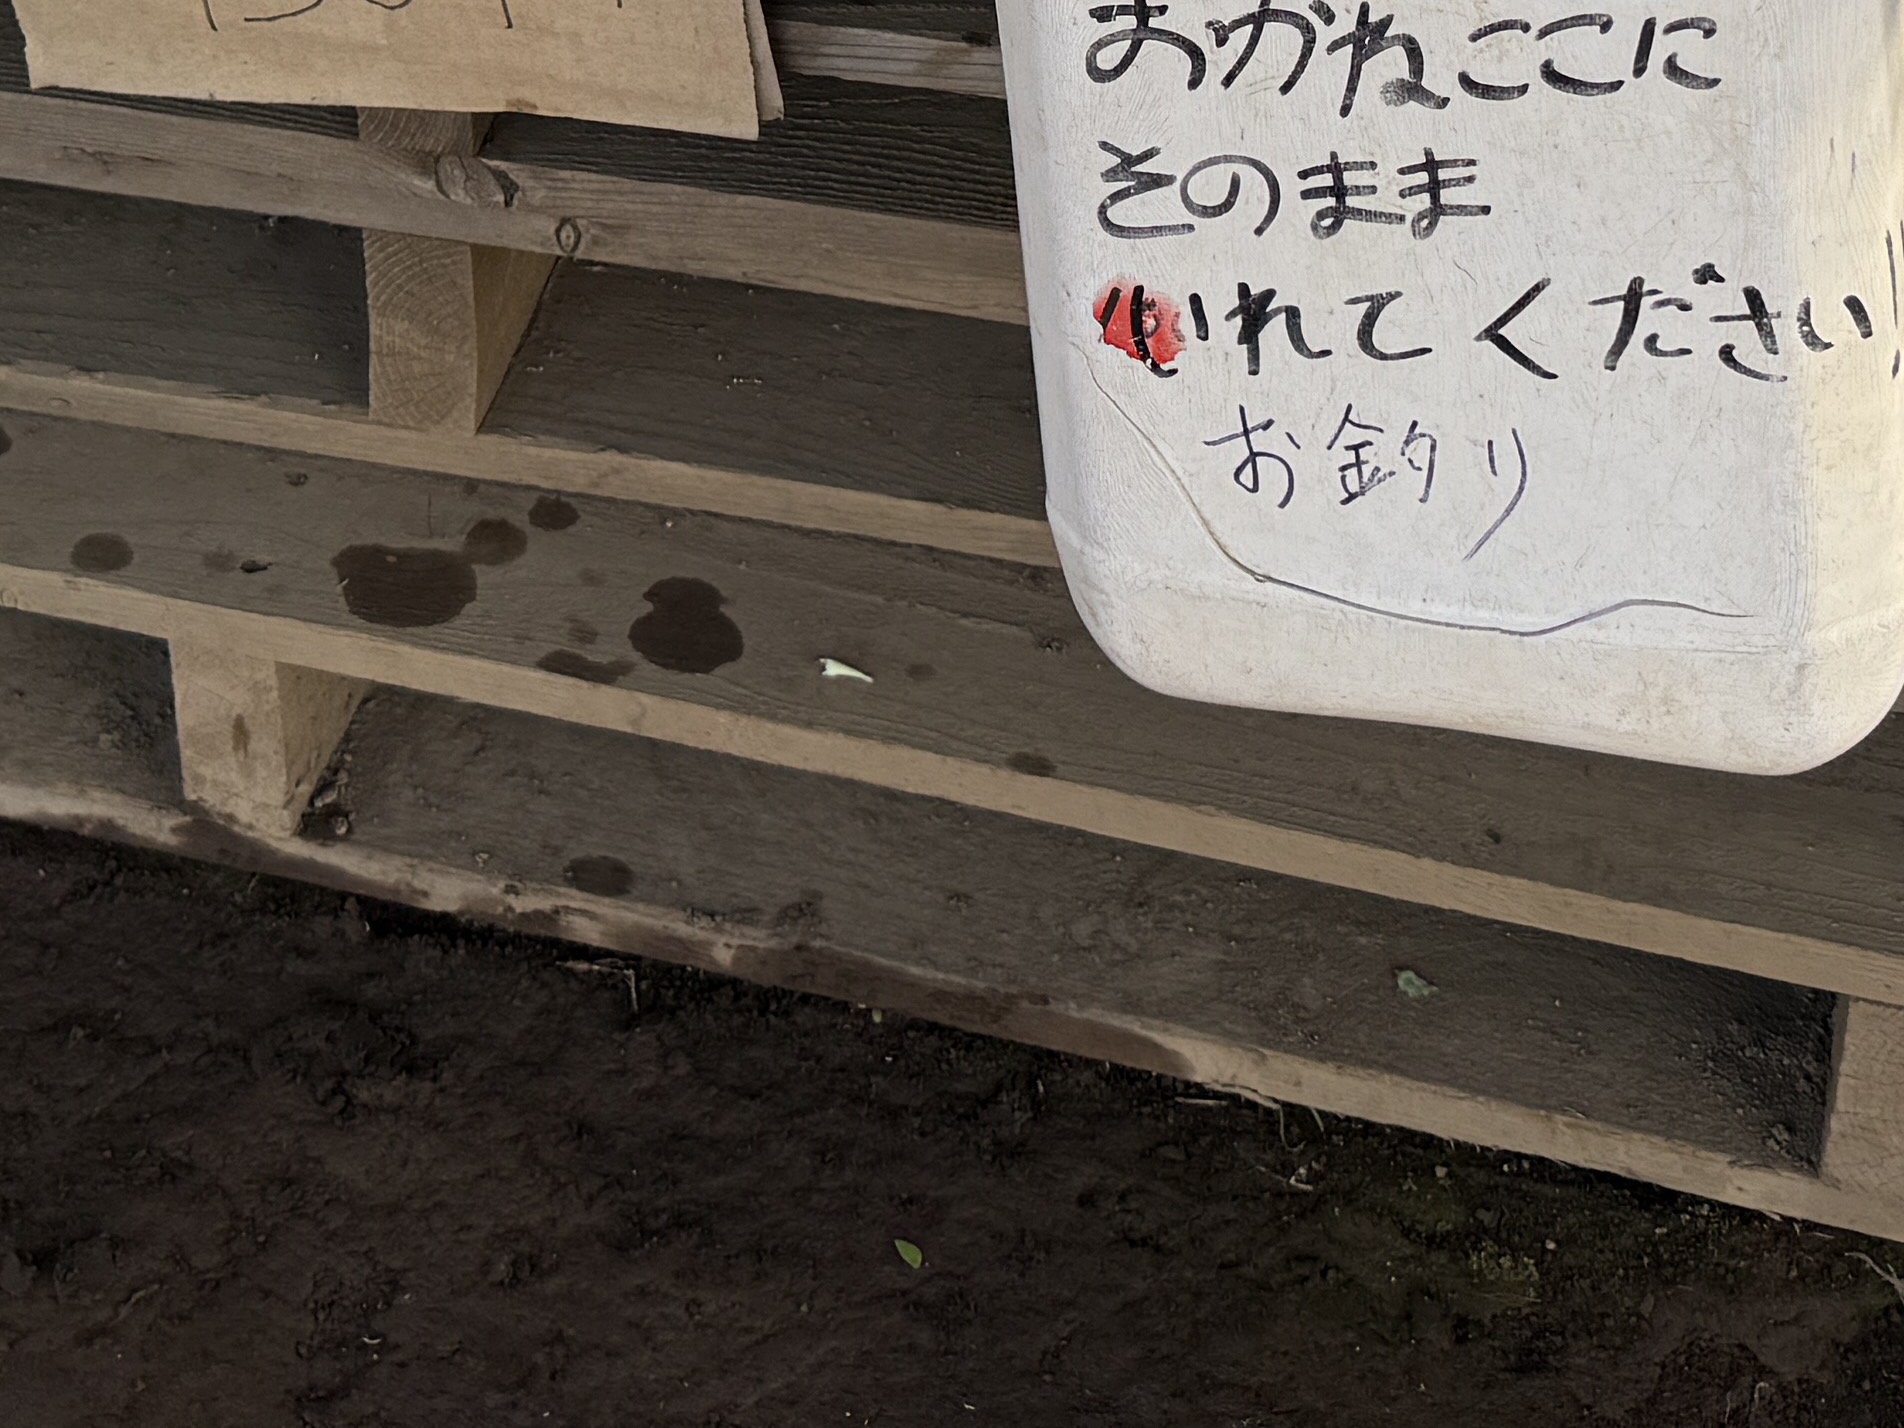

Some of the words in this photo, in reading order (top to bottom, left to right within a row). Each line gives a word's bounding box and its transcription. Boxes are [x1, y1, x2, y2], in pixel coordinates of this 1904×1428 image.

[1096, 140, 1492, 240] そのまま
[1204, 403, 1530, 561] お釣り
